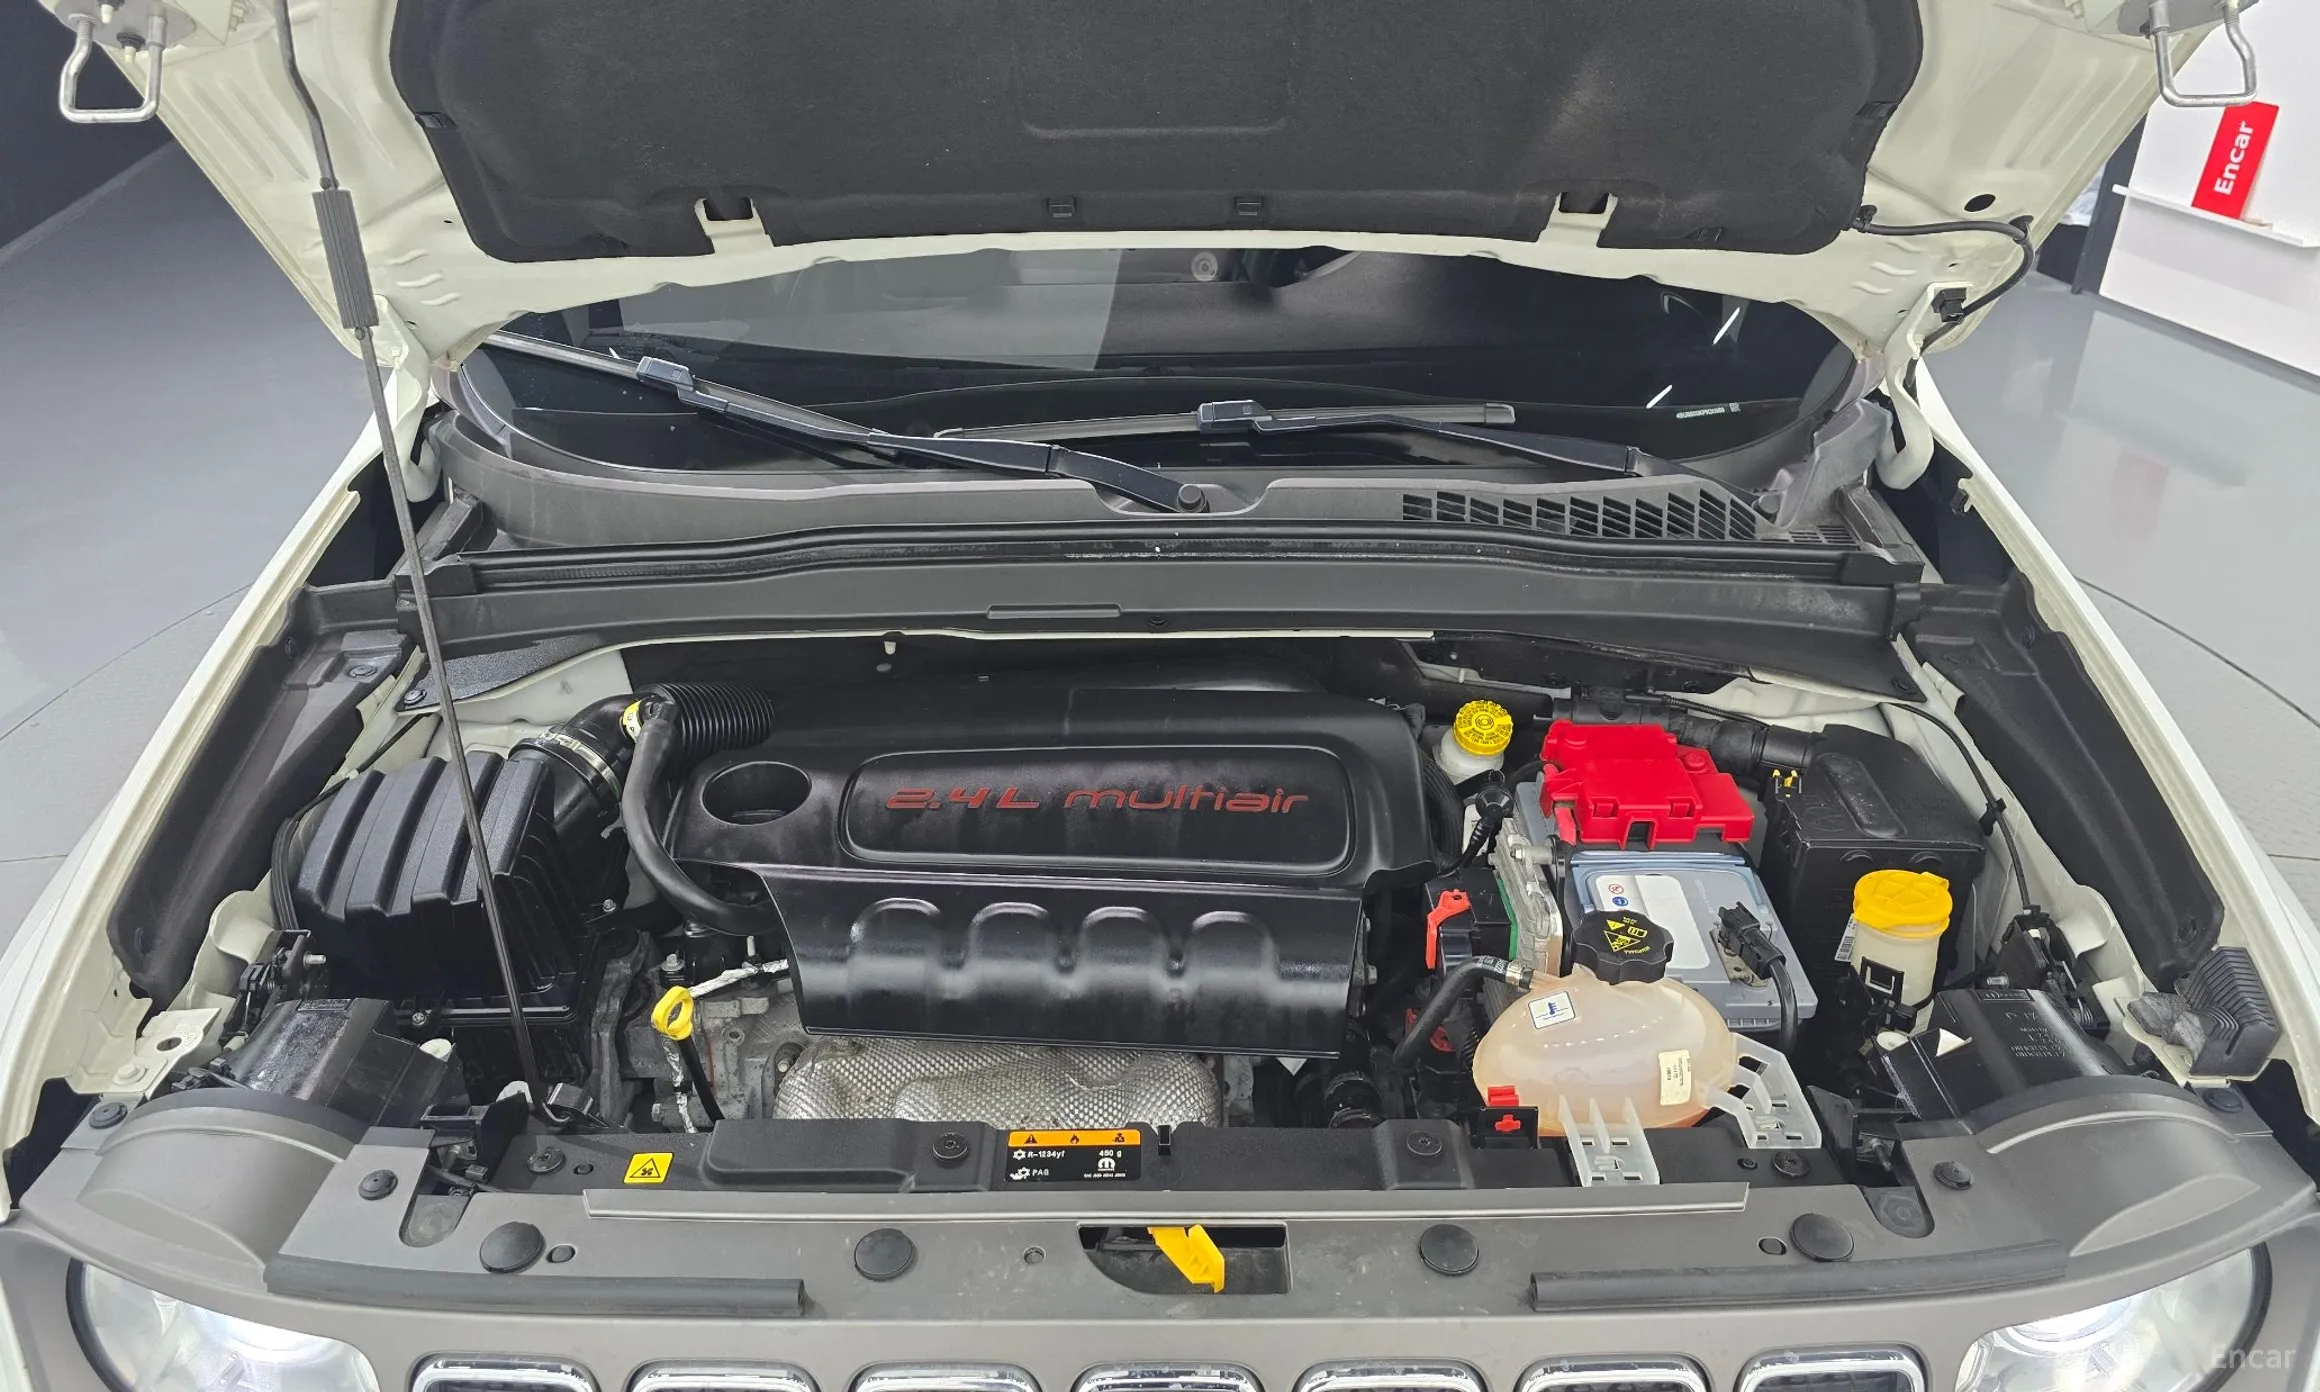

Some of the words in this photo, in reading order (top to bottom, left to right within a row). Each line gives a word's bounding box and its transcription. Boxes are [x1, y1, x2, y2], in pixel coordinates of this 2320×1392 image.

[2213, 120, 2254, 196] Encar
[1063, 783, 1309, 814] multiair
[1027, 1150, 1066, 1160] R-1234yf
